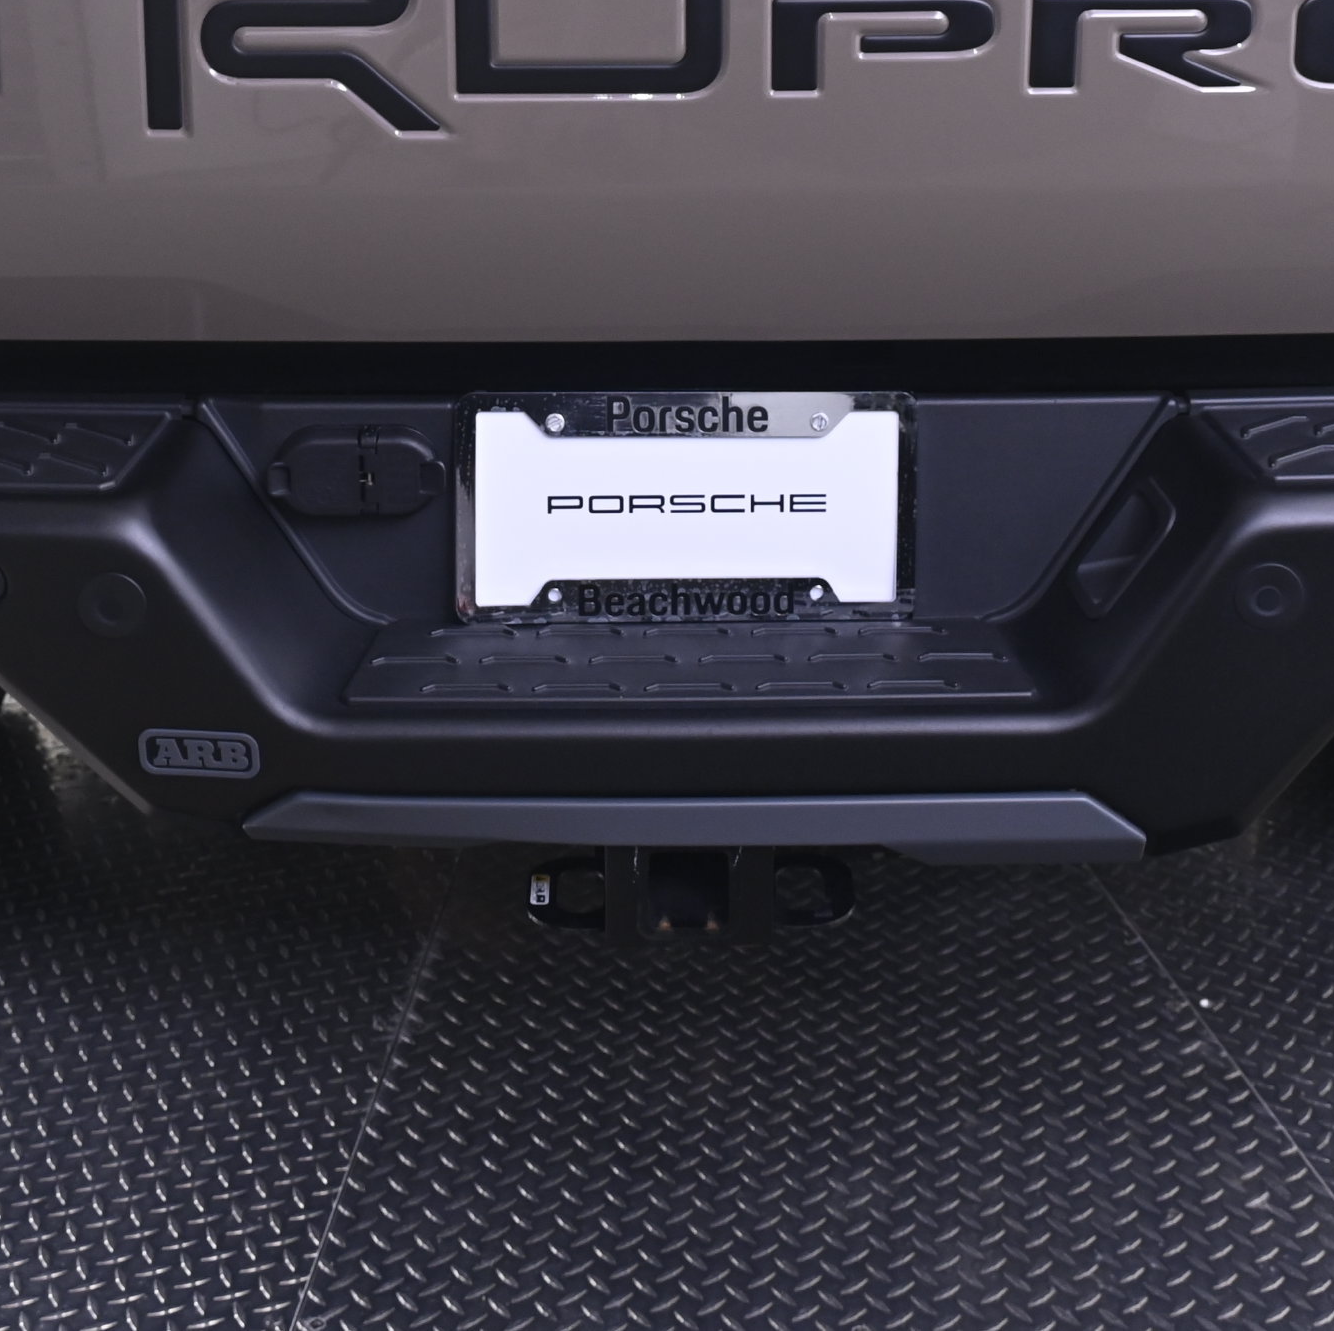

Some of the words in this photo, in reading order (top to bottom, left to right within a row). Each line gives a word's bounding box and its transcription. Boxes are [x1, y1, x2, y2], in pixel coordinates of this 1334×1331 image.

[606, 396, 770, 434] Porsche
[547, 494, 827, 514] PORSCHE
[578, 585, 795, 617] Beachwood
[153, 738, 249, 770] ARB
